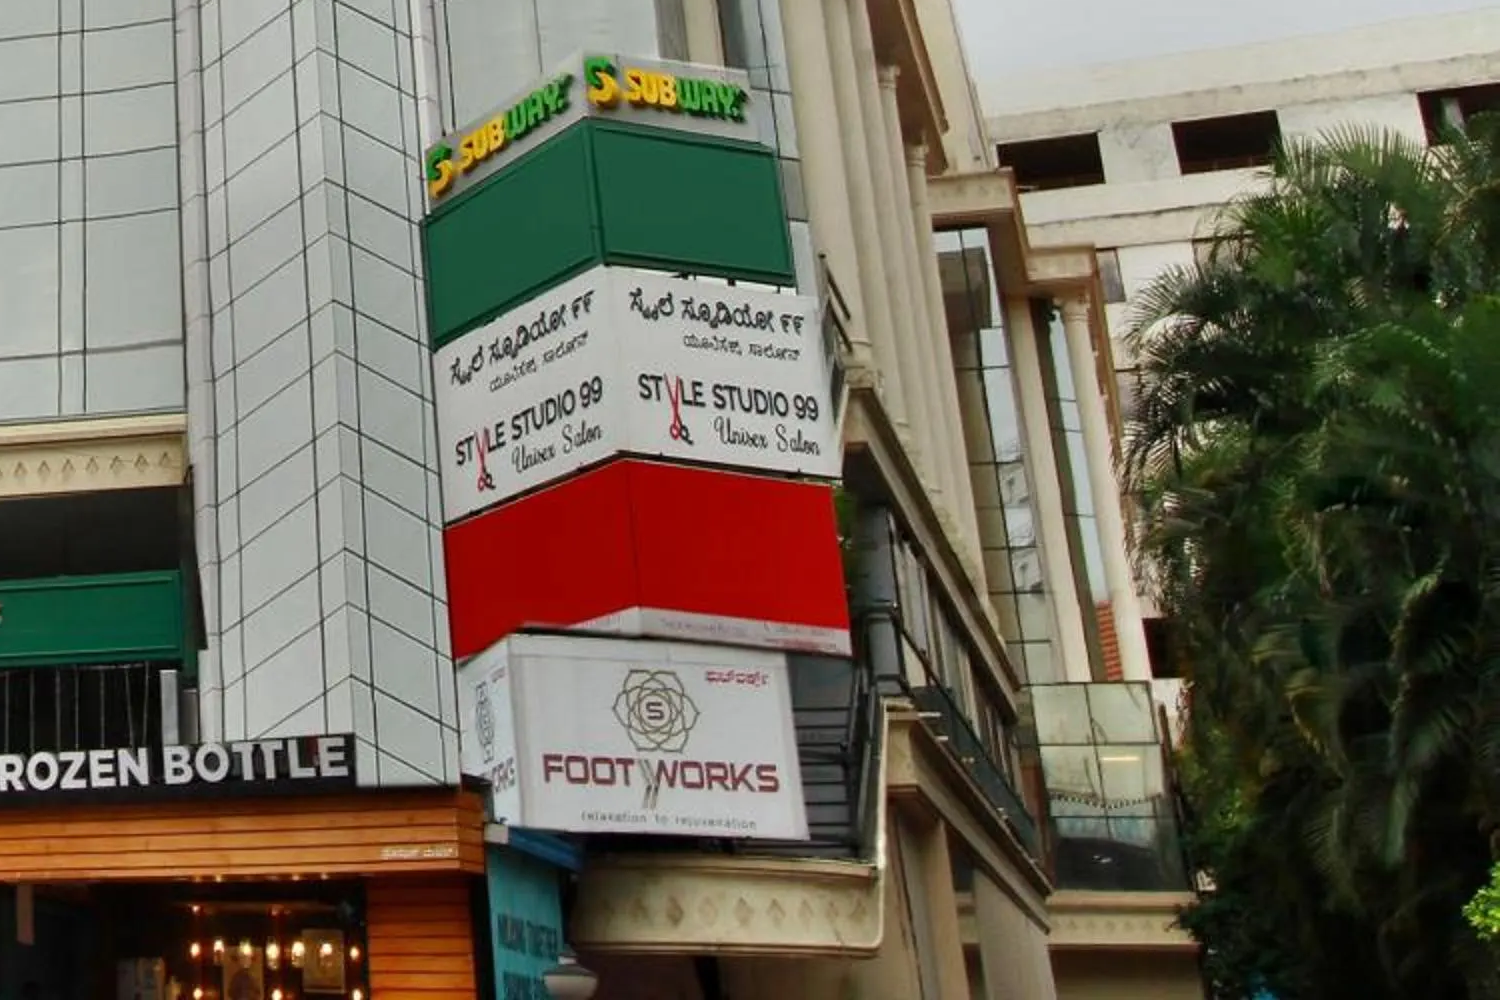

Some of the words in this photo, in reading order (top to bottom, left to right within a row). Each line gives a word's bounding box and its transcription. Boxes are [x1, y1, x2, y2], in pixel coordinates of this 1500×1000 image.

[638, 372, 706, 420] STYLE
[711, 383, 789, 417] STUDIO
[792, 394, 820, 422] 99
[456, 420, 507, 476] STYLE
[511, 388, 576, 441] STUDIO
[579, 374, 604, 409] 99
[511, 443, 556, 475] Unisex
[561, 419, 603, 455] Salon
[713, 415, 769, 450] Unisex
[775, 423, 821, 456] Salon
[161, 735, 350, 787] BOTTLE
[580, 810, 647, 824] relaxation
[654, 812, 669, 826] to
[675, 813, 757, 830] rejuvenation
